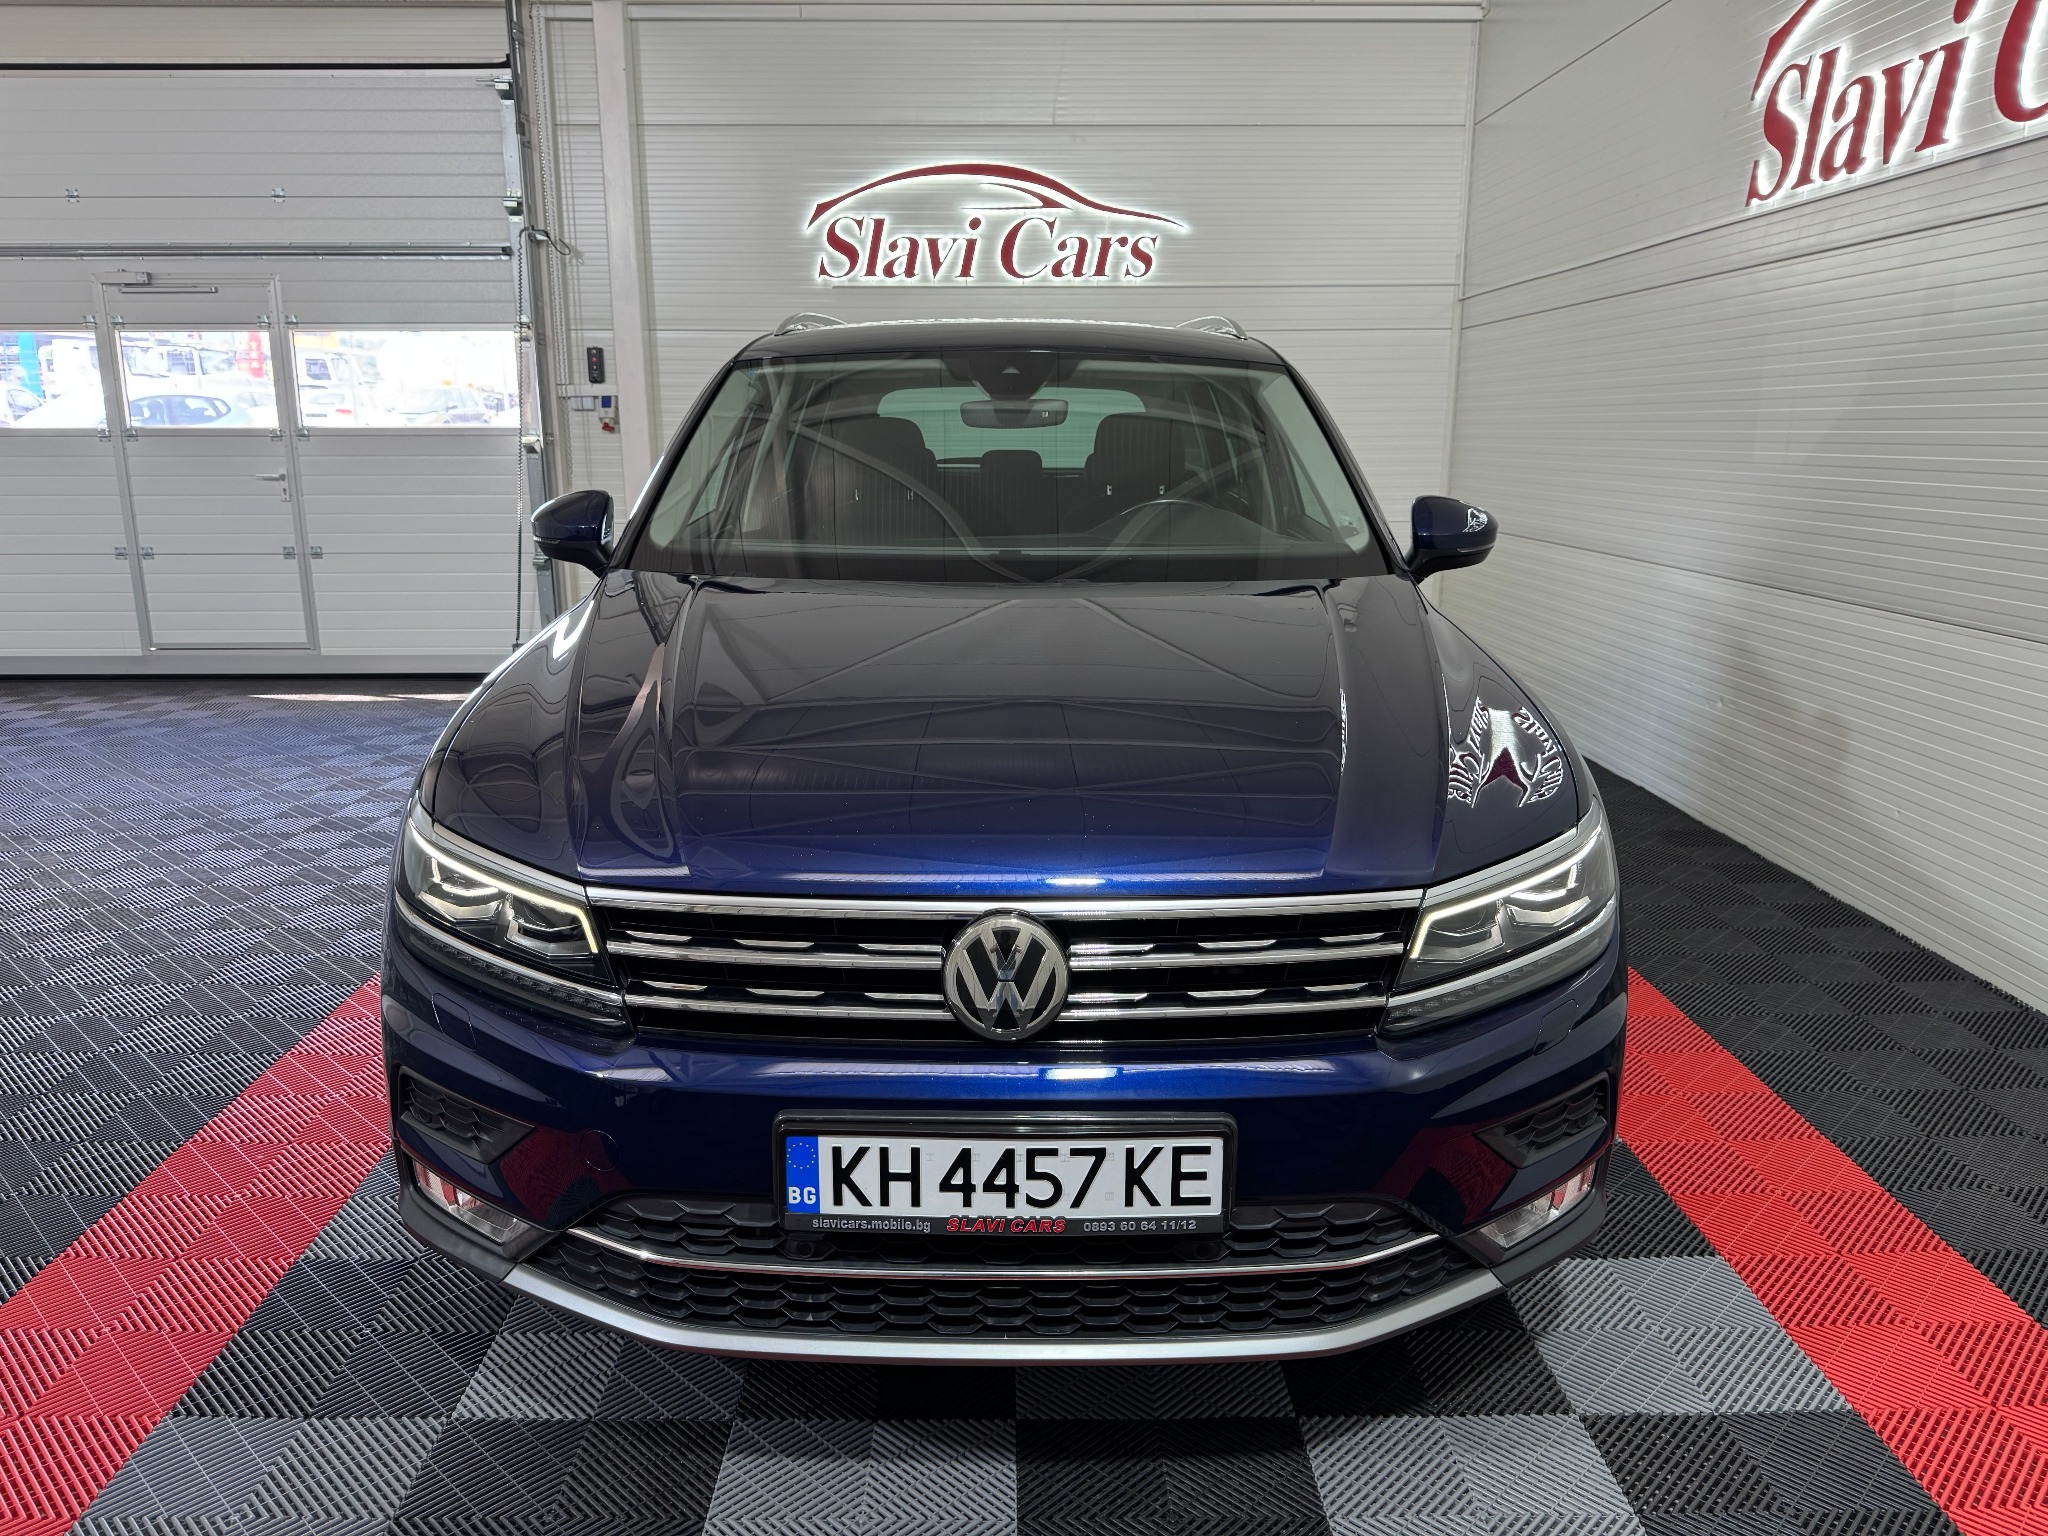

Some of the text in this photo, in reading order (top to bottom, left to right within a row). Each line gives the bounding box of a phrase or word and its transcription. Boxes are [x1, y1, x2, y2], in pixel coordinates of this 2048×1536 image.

[1745, 0, 1970, 207] Slavi
[817, 216, 1159, 280] Slavi Cars
[831, 1145, 1212, 1209] KH 4457 KE
[788, 1186, 817, 1205] BG
[812, 1217, 931, 1234] slavicars.mobile.bg
[946, 1216, 1067, 1234] SLAVI CARS
[1083, 1219, 1197, 1233] 0893 60 64 11/12
